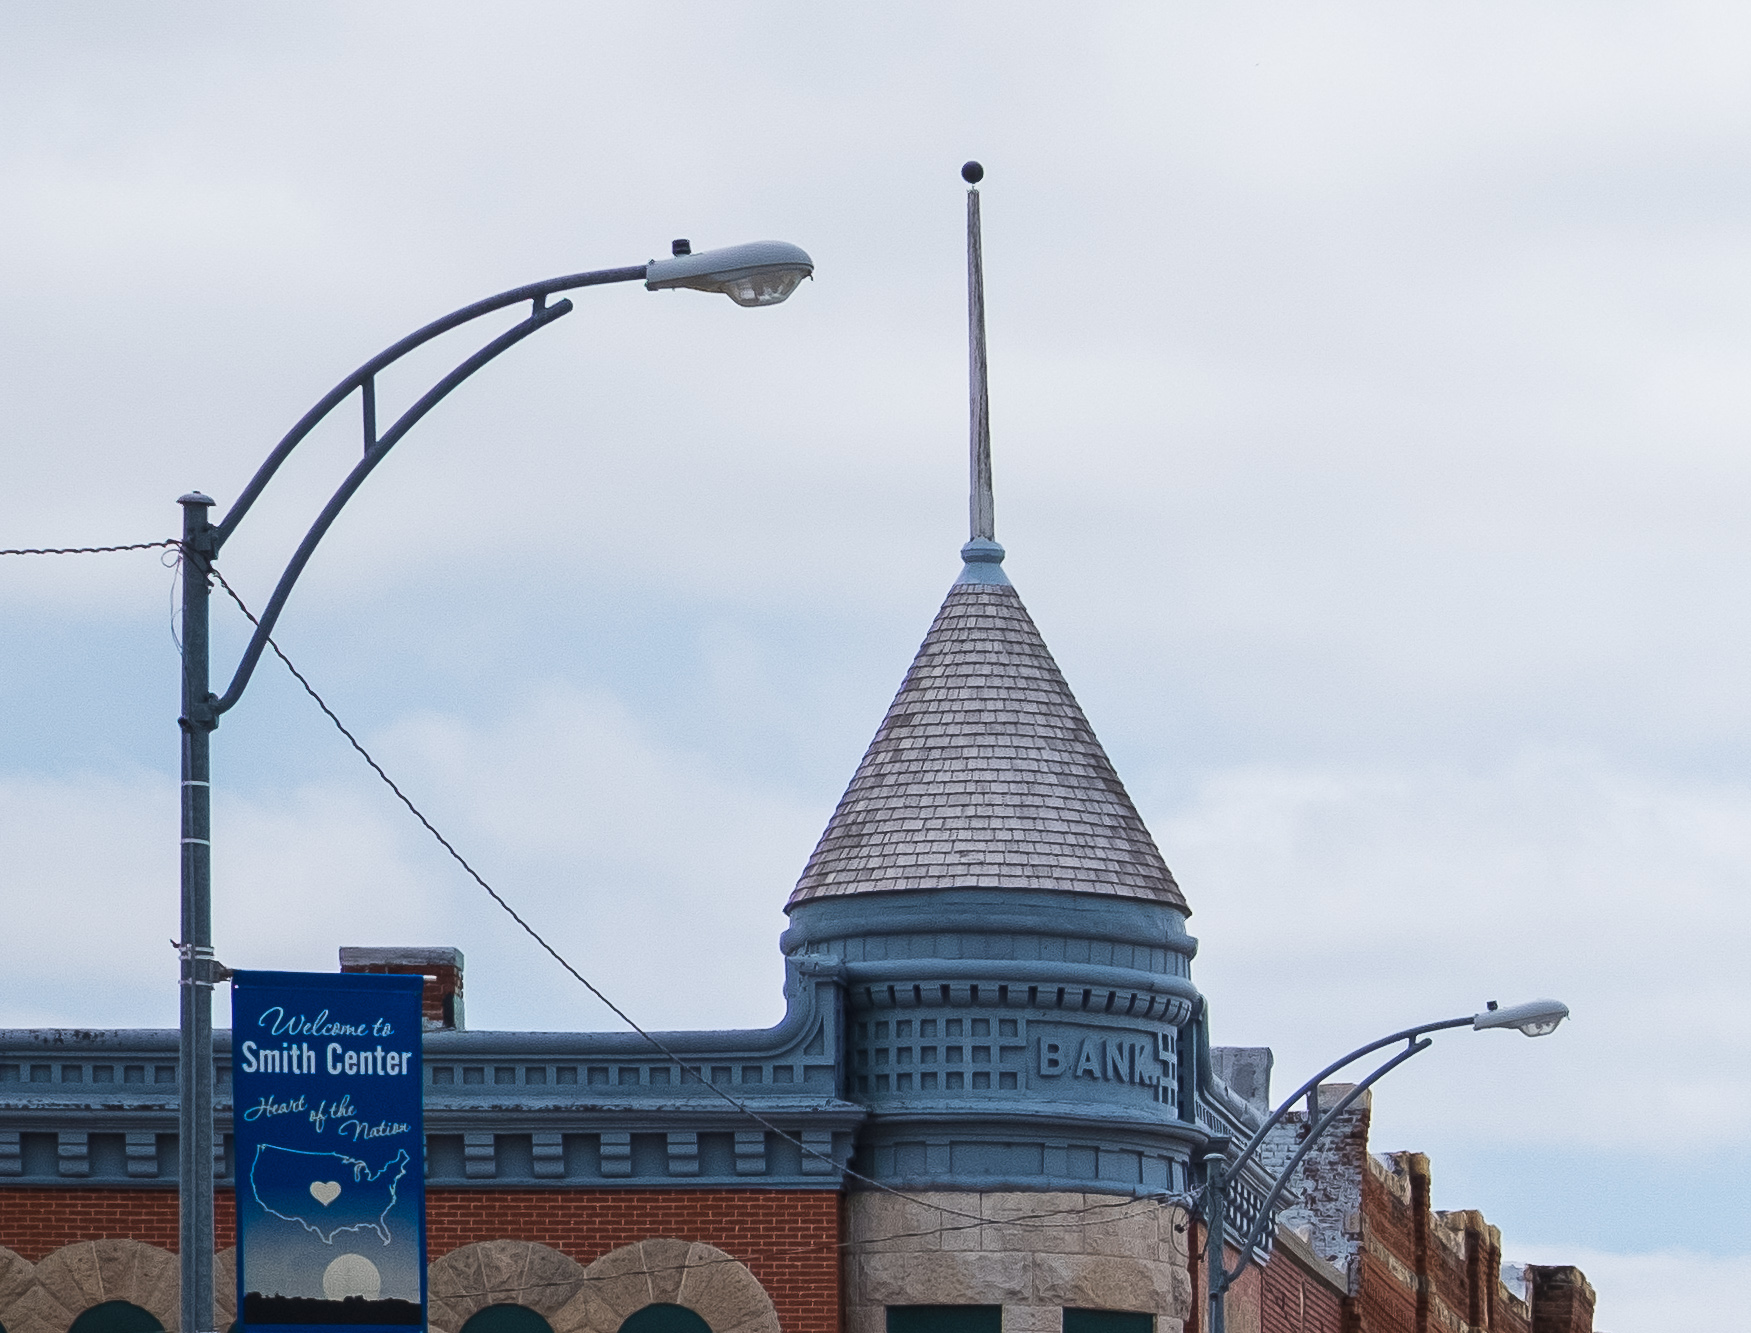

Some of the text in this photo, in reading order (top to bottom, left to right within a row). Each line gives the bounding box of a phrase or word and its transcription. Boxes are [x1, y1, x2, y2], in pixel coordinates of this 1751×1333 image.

[258, 1006, 395, 1037] Welcome to
[242, 1041, 412, 1075] Smith Center
[244, 1094, 357, 1133] Heart of the
[338, 1120, 411, 1142] Nation
